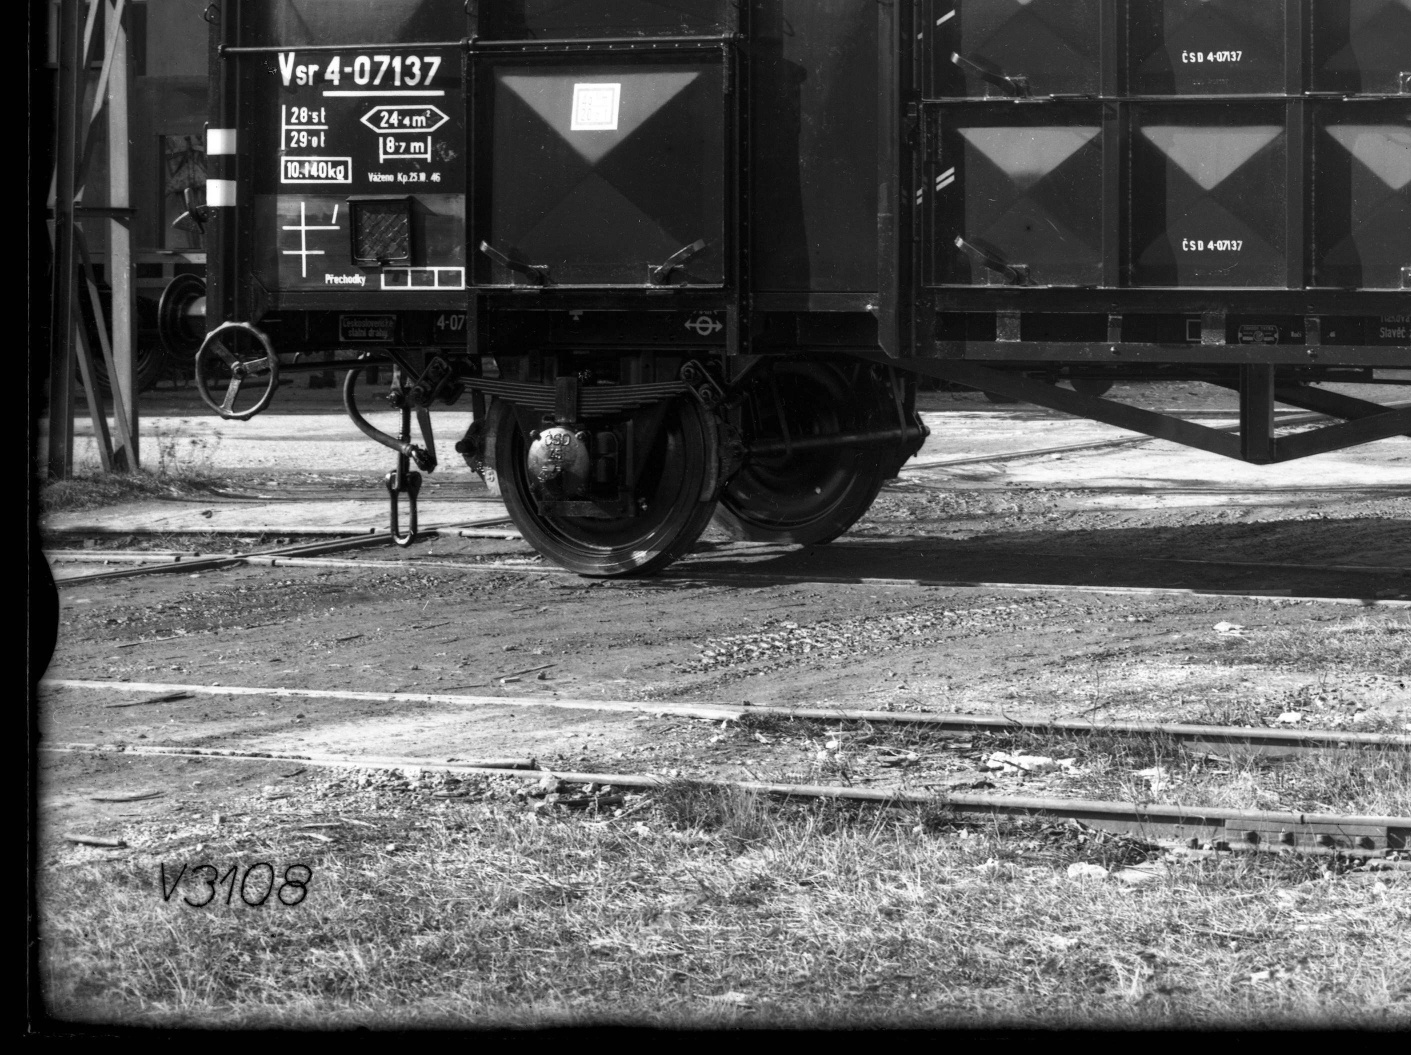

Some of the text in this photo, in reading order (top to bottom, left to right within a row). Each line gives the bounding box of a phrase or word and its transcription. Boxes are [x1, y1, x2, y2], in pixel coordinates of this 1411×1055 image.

[1182, 50, 1243, 63] ČSD 4-07137
[278, 52, 443, 87] Vsr 4-07137
[367, 171, 395, 183] Váženo
[1182, 238, 1243, 251] ČSD 4-07137
[324, 273, 367, 287] Přechodky
